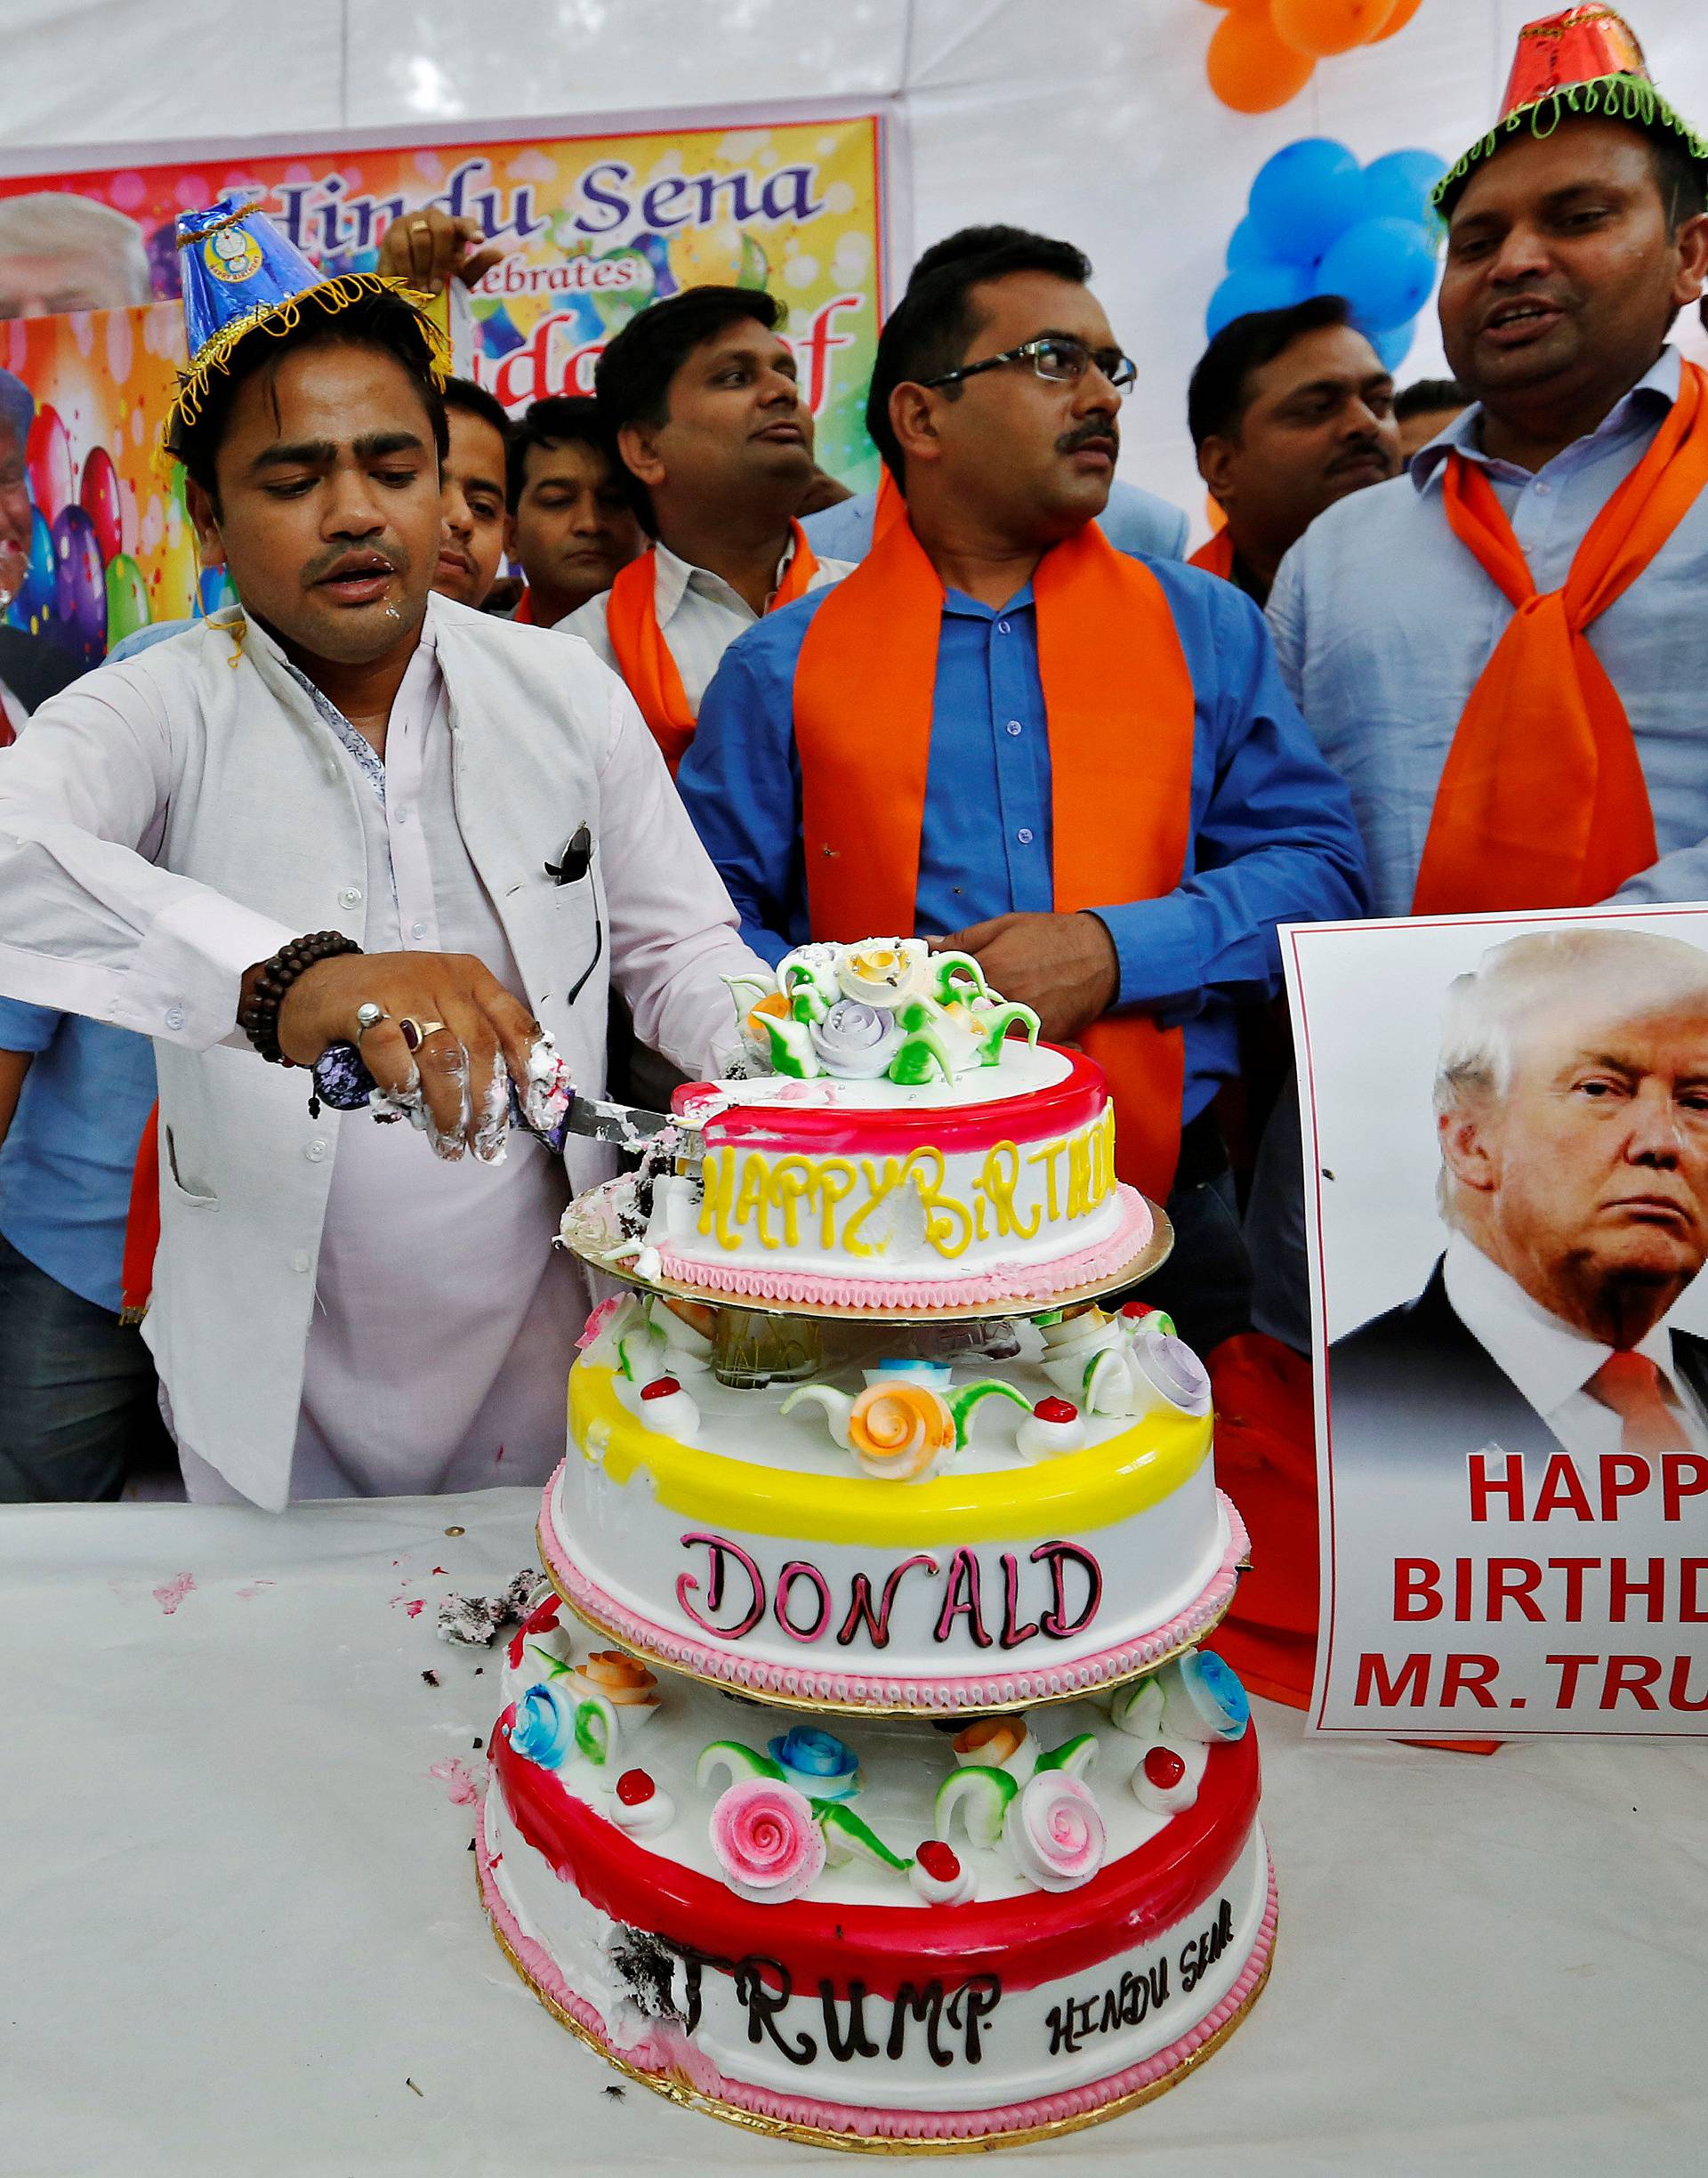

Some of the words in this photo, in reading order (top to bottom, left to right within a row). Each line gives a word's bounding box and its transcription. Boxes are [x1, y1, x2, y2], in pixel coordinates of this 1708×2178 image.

[574, 164, 825, 233] Sena
[469, 257, 633, 294] ebrates
[697, 1145, 897, 1258] HAPPY
[676, 1532, 1103, 1650] DONALD
[1044, 1956, 1170, 2055] HINDU
